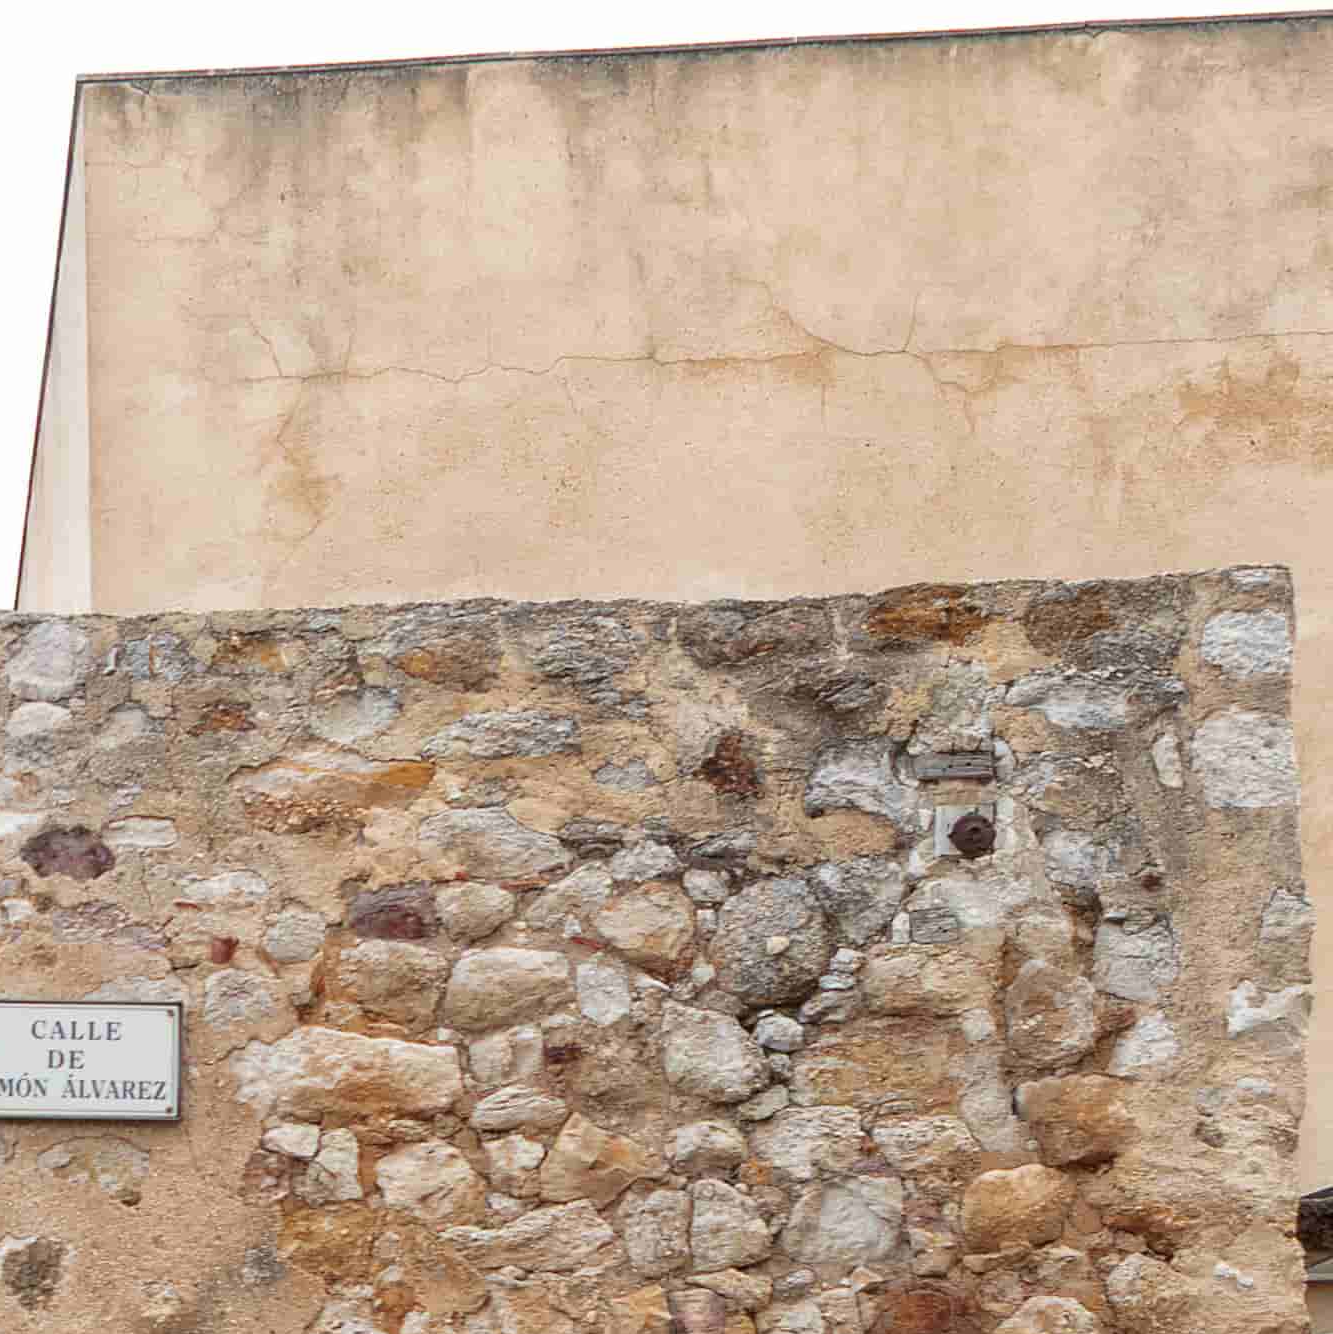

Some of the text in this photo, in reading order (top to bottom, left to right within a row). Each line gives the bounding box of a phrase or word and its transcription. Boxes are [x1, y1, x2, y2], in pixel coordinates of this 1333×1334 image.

[30, 1019, 122, 1041] CALLE
[47, 1049, 86, 1069] DE
[61, 1074, 166, 1100] ÁLVAREZ
